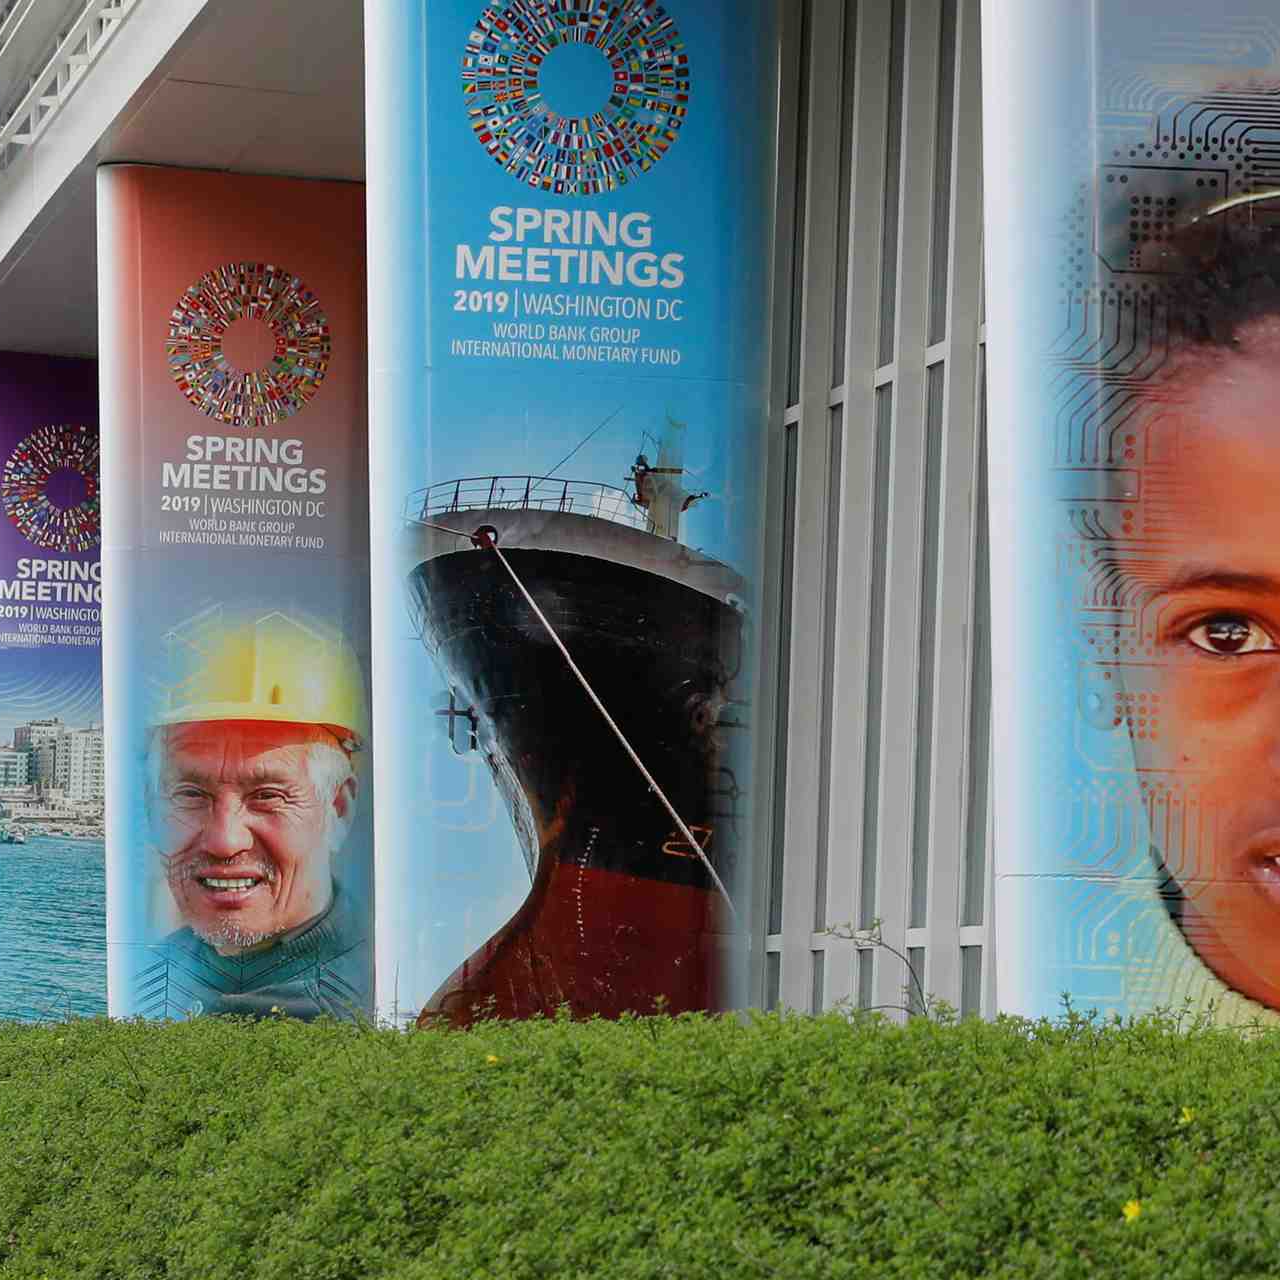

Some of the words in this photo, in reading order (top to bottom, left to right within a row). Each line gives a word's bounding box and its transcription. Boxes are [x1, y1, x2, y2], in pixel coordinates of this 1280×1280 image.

[488, 205, 652, 248] SPRING
[455, 244, 685, 289] MEETINGS
[453, 289, 509, 313] 2019
[523, 292, 650, 320] WASHINGTON
[655, 298, 684, 321] DC
[493, 322, 545, 340] WORLD
[549, 324, 587, 342] BANK
[591, 326, 641, 344] GROUP
[451, 339, 560, 361] INTERNATIONAL
[562, 344, 638, 364] MONETARY
[641, 347, 681, 366] FUND
[185, 435, 304, 465] SPRING
[162, 462, 327, 494] MEETINGS
[161, 495, 200, 512] 2019
[210, 497, 302, 517] WASHINGTON
[306, 501, 327, 518] DC
[159, 530, 236, 545] INTERNATIONAL
[239, 534, 293, 547] MONETARY
[295, 536, 325, 549] FUND
[188, 518, 227, 532] WORLD
[230, 520, 257, 533] BANK
[258, 521, 296, 534] GROUP
[18, 623, 48, 634] WORLD
[50, 625, 71, 634] BANK
